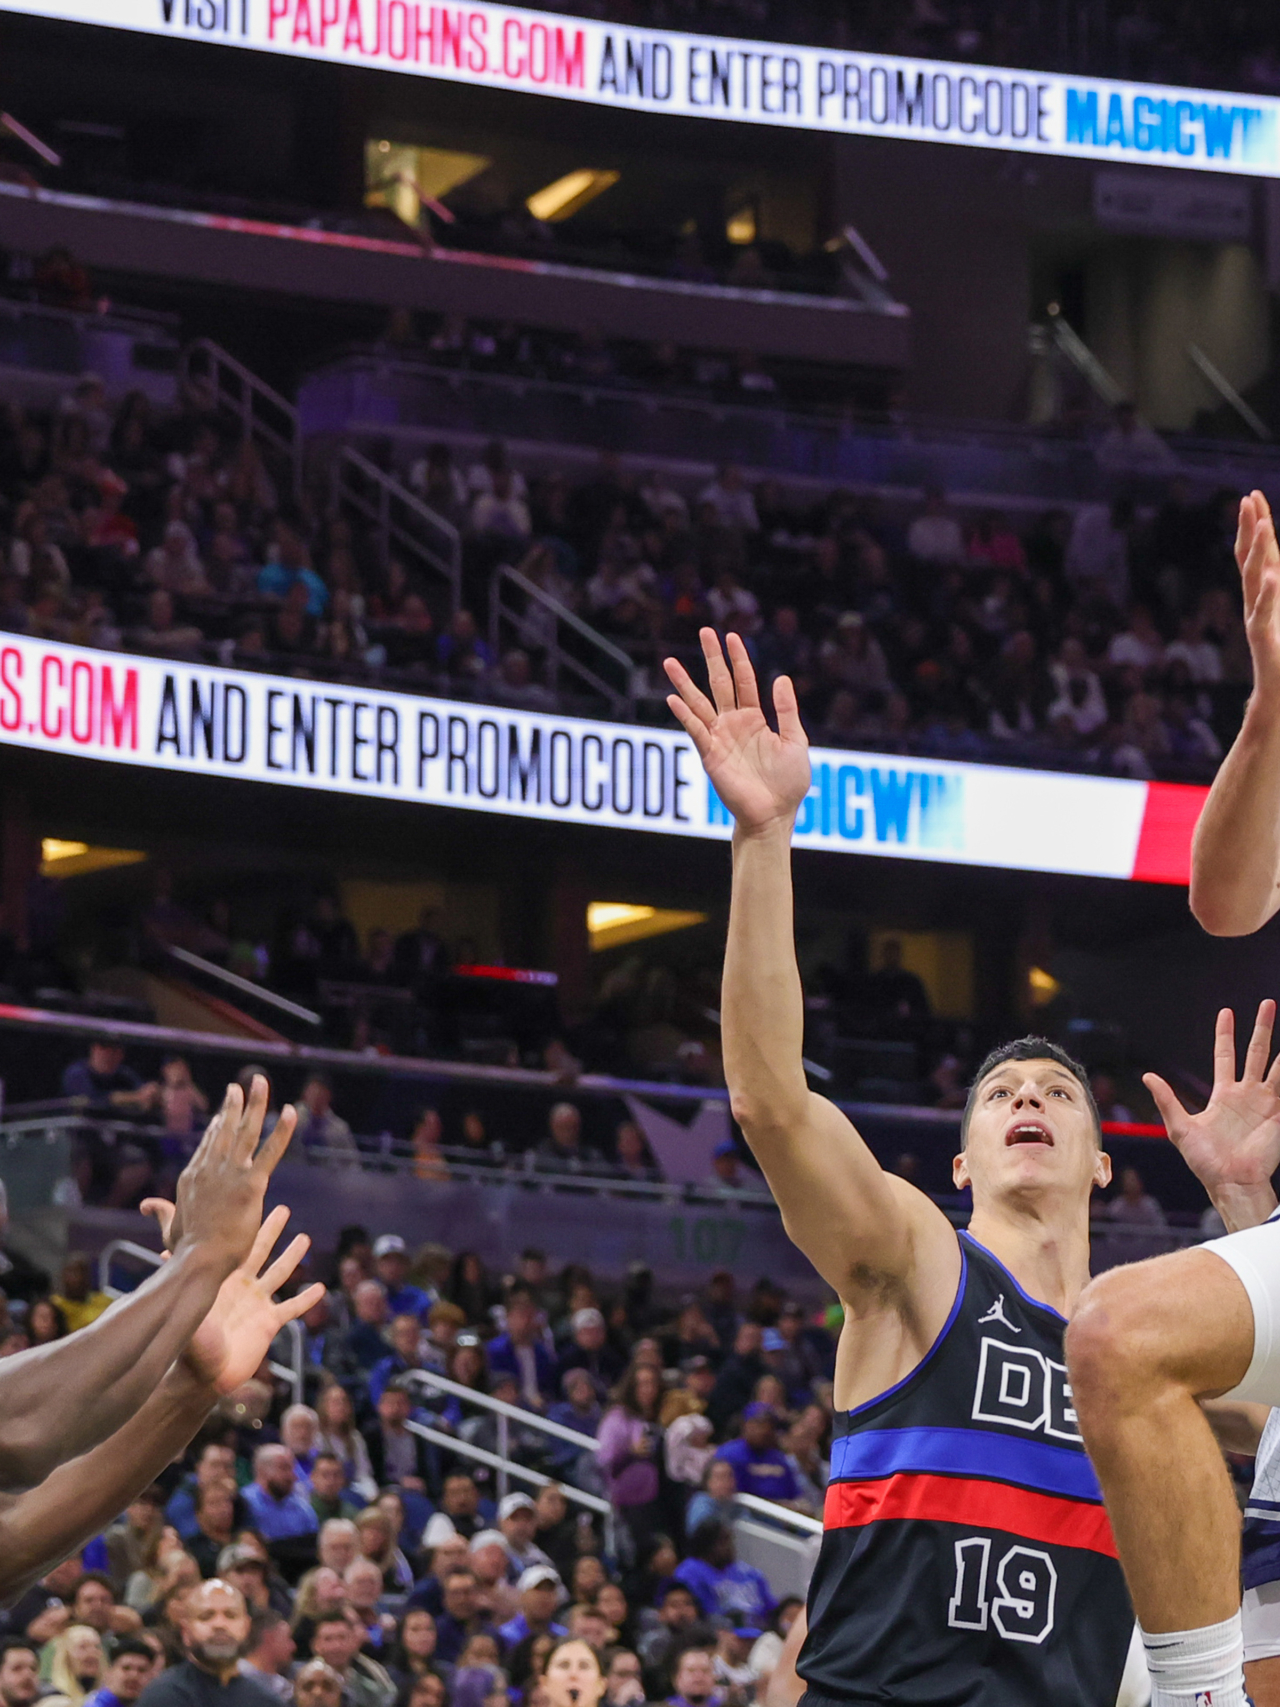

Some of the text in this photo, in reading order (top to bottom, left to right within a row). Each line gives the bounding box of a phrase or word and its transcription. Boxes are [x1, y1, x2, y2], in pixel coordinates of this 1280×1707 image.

[267, 0, 585, 89] PAPAJOHNS.COM
[600, 36, 672, 100] AND
[688, 47, 802, 116] ENTER
[818, 60, 1051, 142] PROMOCODE
[156, 675, 247, 763] AND
[267, 689, 399, 785] ENTER
[418, 711, 690, 822] PROMOCODE
[948, 1536, 1058, 1645] 19
